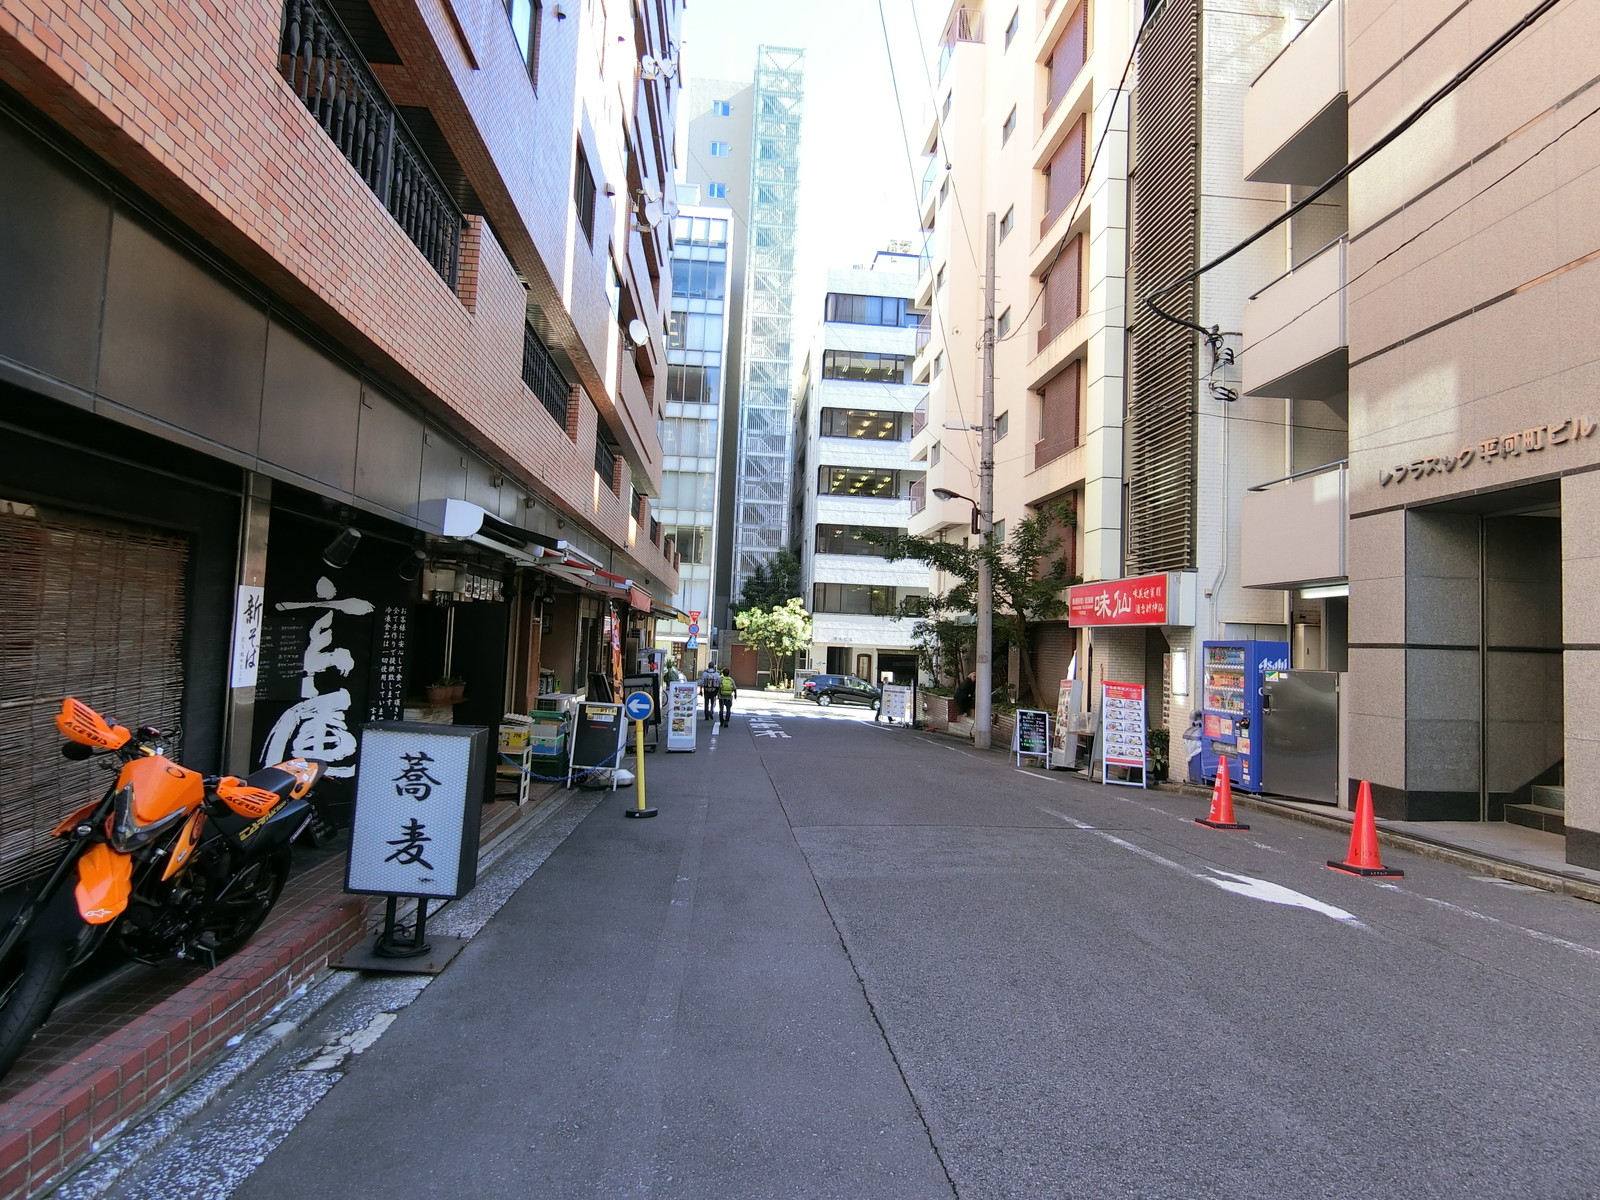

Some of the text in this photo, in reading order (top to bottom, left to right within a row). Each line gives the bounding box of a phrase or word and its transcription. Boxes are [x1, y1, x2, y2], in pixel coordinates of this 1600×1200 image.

[1094, 590, 1132, 619] 味仙
[243, 594, 262, 670] 新そば
[1258, 657, 1288, 671] Asahi
[384, 751, 442, 870] 蕎麦
